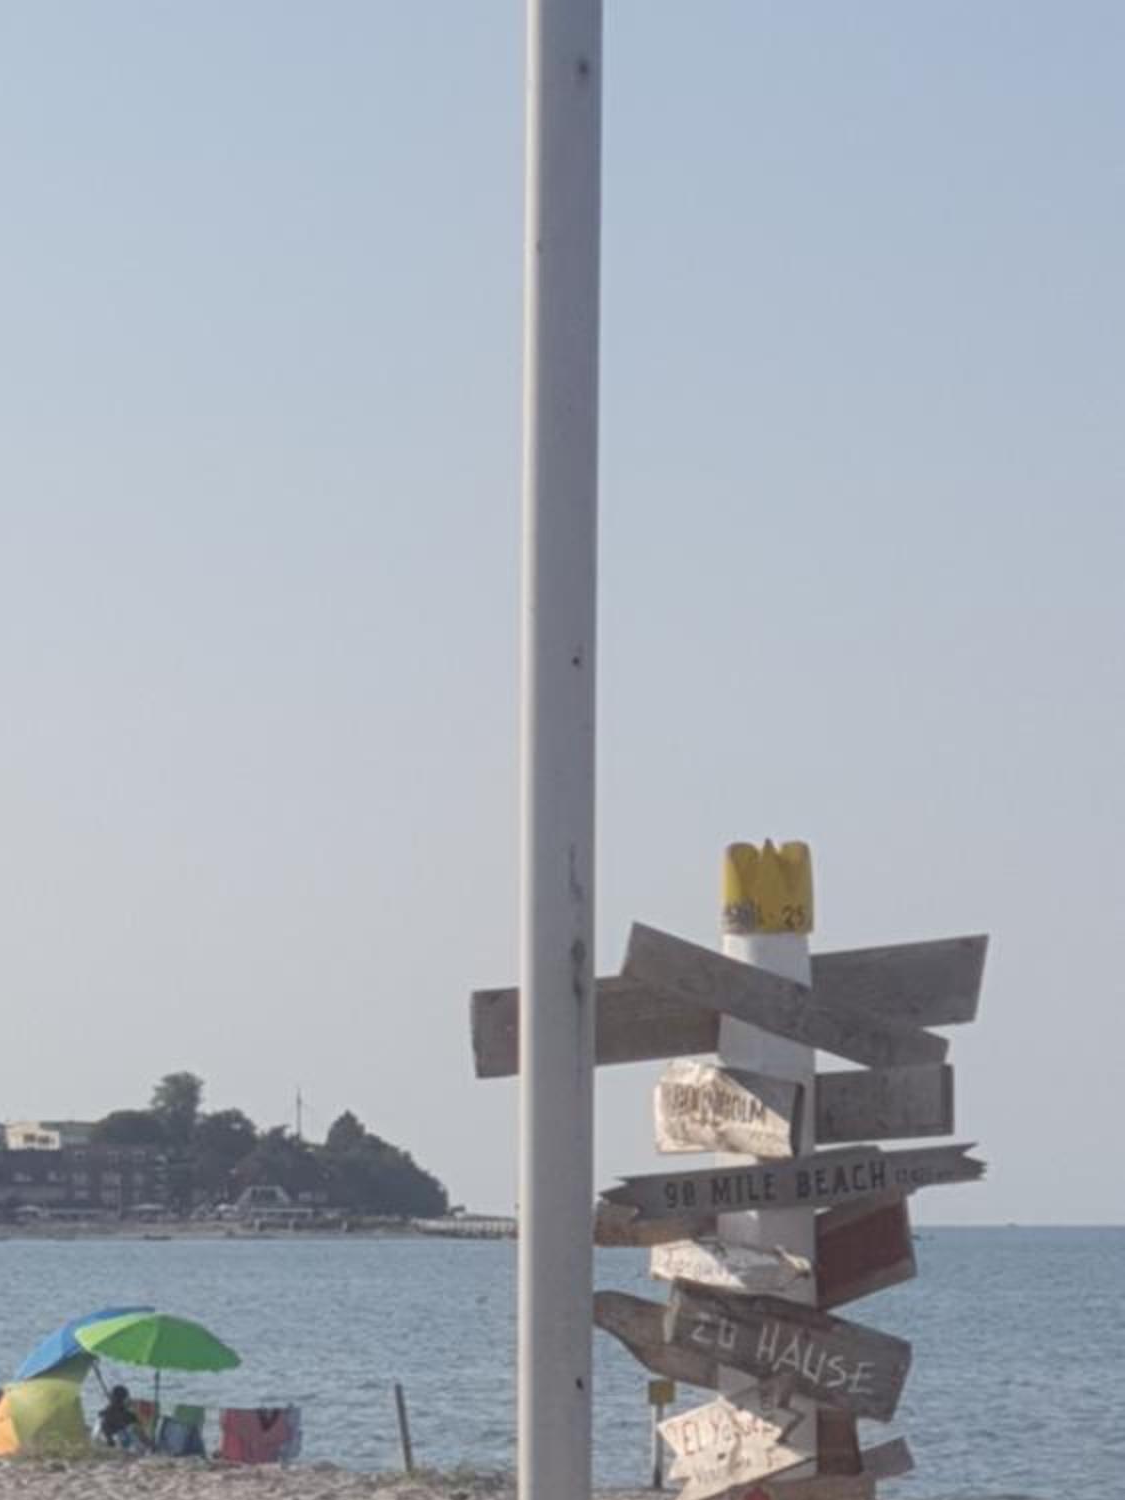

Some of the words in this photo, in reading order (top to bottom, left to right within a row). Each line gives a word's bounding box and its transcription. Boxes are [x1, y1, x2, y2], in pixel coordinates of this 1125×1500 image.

[711, 1171, 776, 1205] MILE
[795, 1159, 887, 1199] BEACH
[755, 1322, 876, 1394] HAUSE
